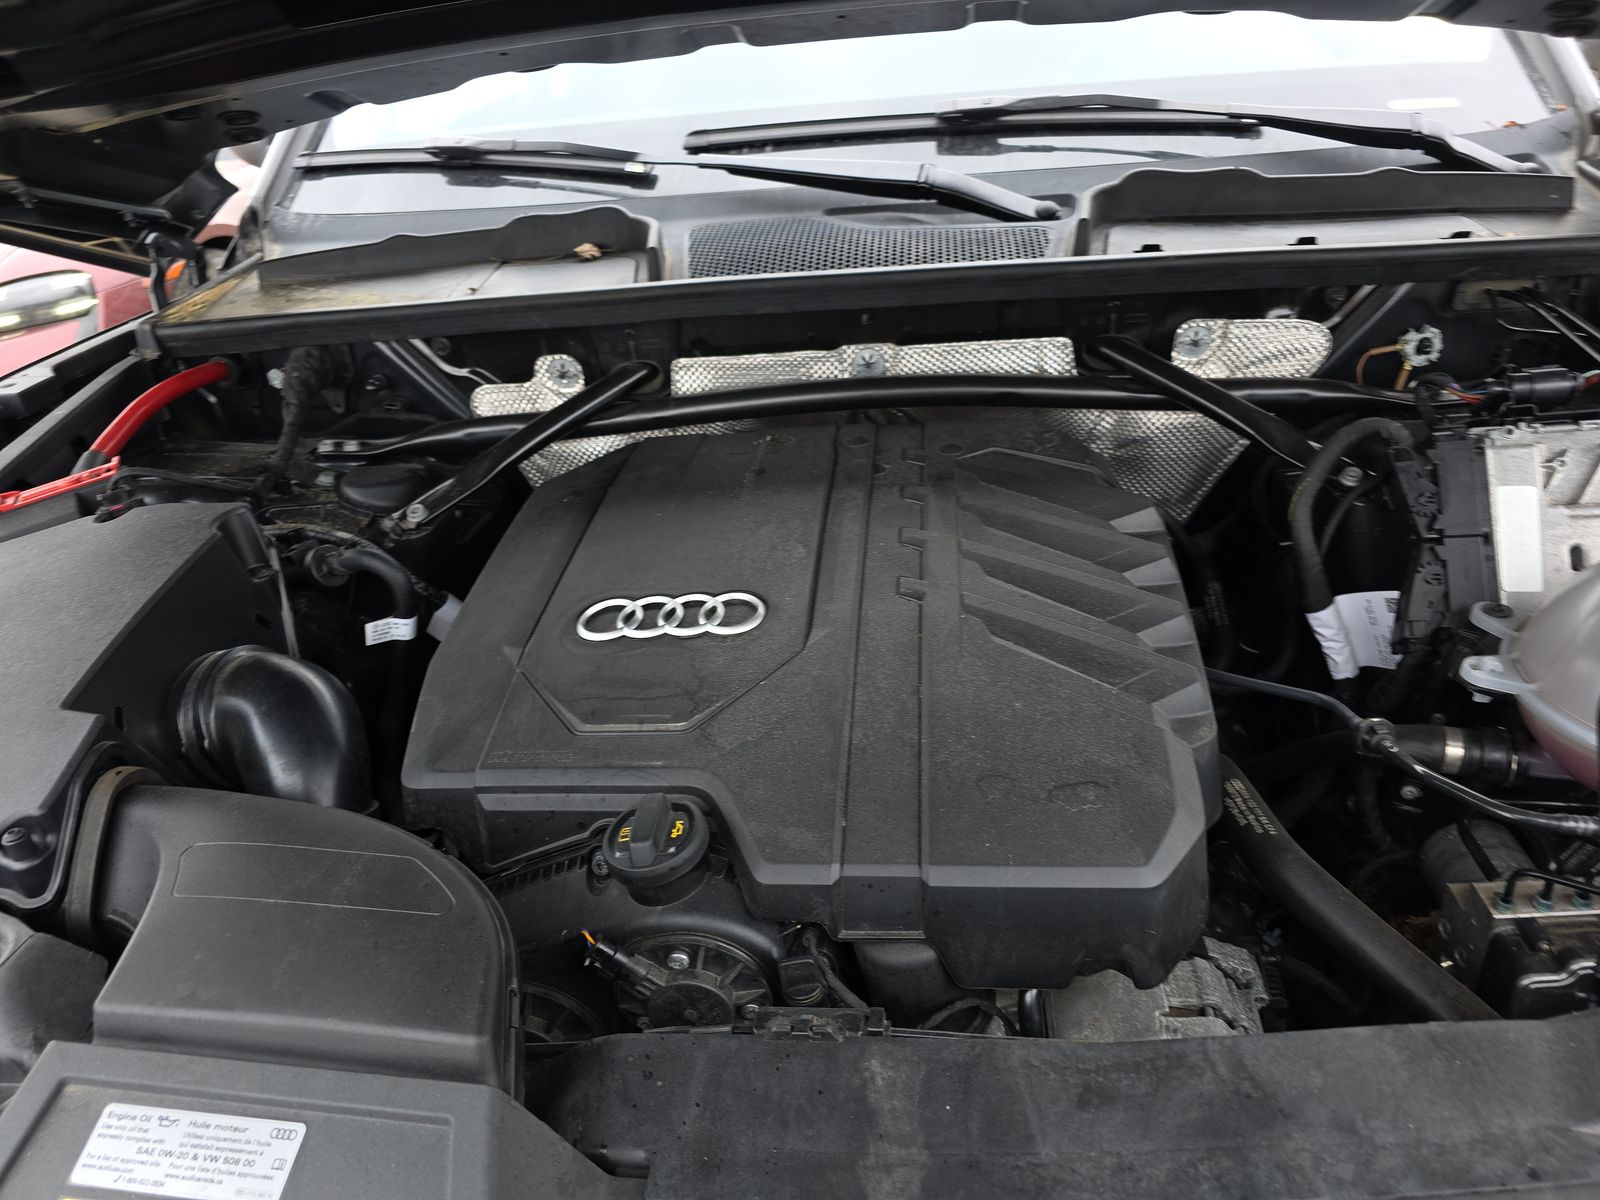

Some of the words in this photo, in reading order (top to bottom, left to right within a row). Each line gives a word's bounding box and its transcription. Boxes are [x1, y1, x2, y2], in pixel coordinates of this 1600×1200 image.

[107, 1110, 137, 1121] Engine
[139, 1114, 153, 1122] Oil
[188, 1119, 211, 1130] Huile
[213, 1123, 249, 1133] moteur
[135, 1146, 157, 1156] SAE
[157, 1149, 190, 1160] 0W-20
[203, 1153, 221, 1163] VW
[222, 1156, 240, 1166] 508
[242, 1158, 256, 1168] 00
